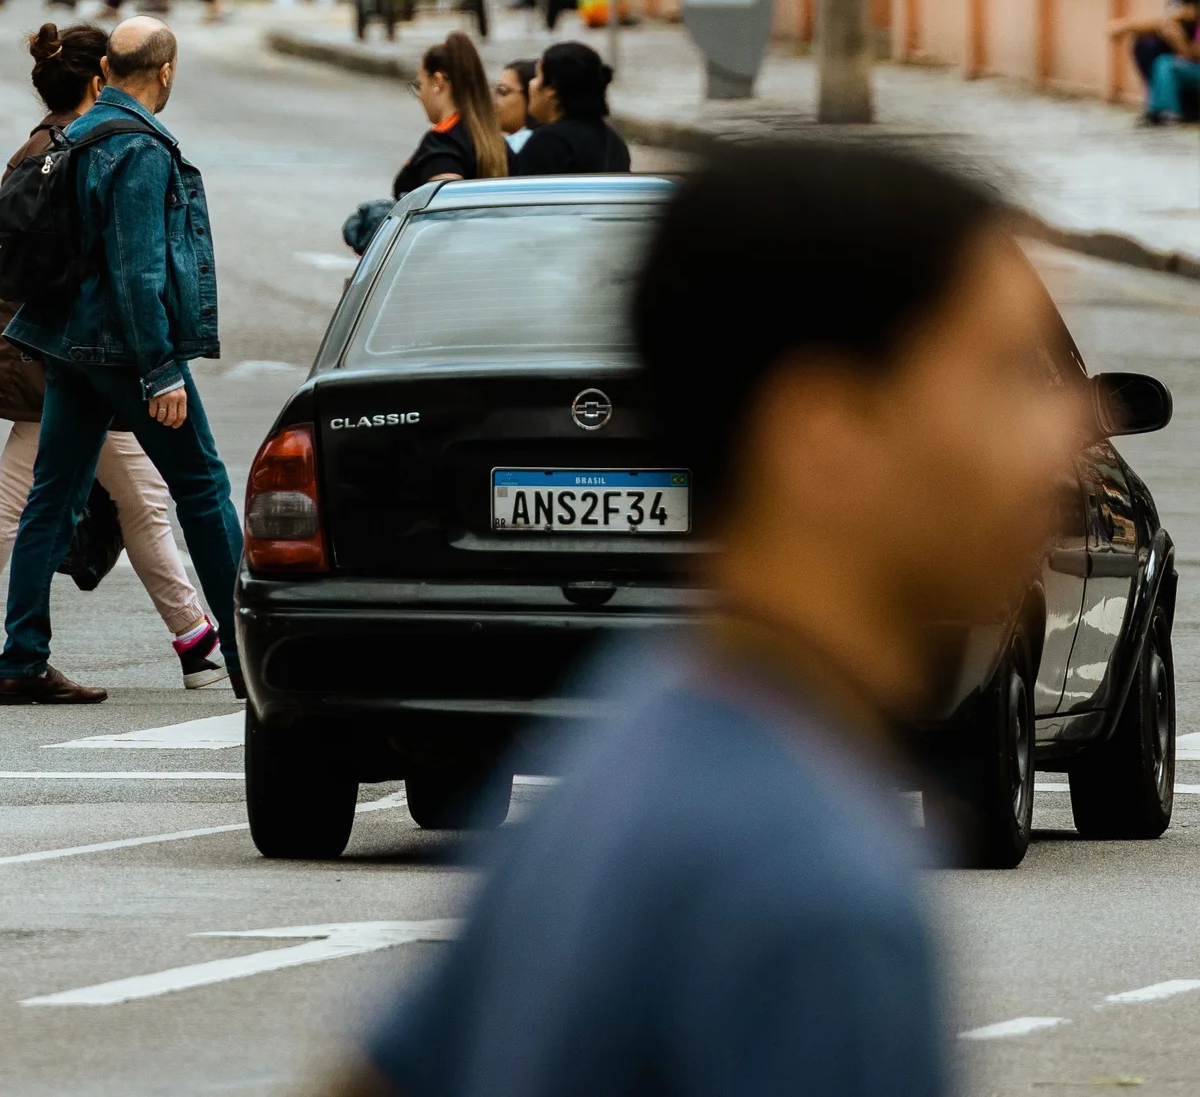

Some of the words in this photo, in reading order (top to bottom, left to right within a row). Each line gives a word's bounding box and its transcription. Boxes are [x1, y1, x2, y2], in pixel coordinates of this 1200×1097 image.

[330, 411, 420, 430] CLASSIC
[575, 476, 606, 484] BRASIL
[511, 490, 668, 525] ANS2F34
[494, 517, 506, 528] BR
